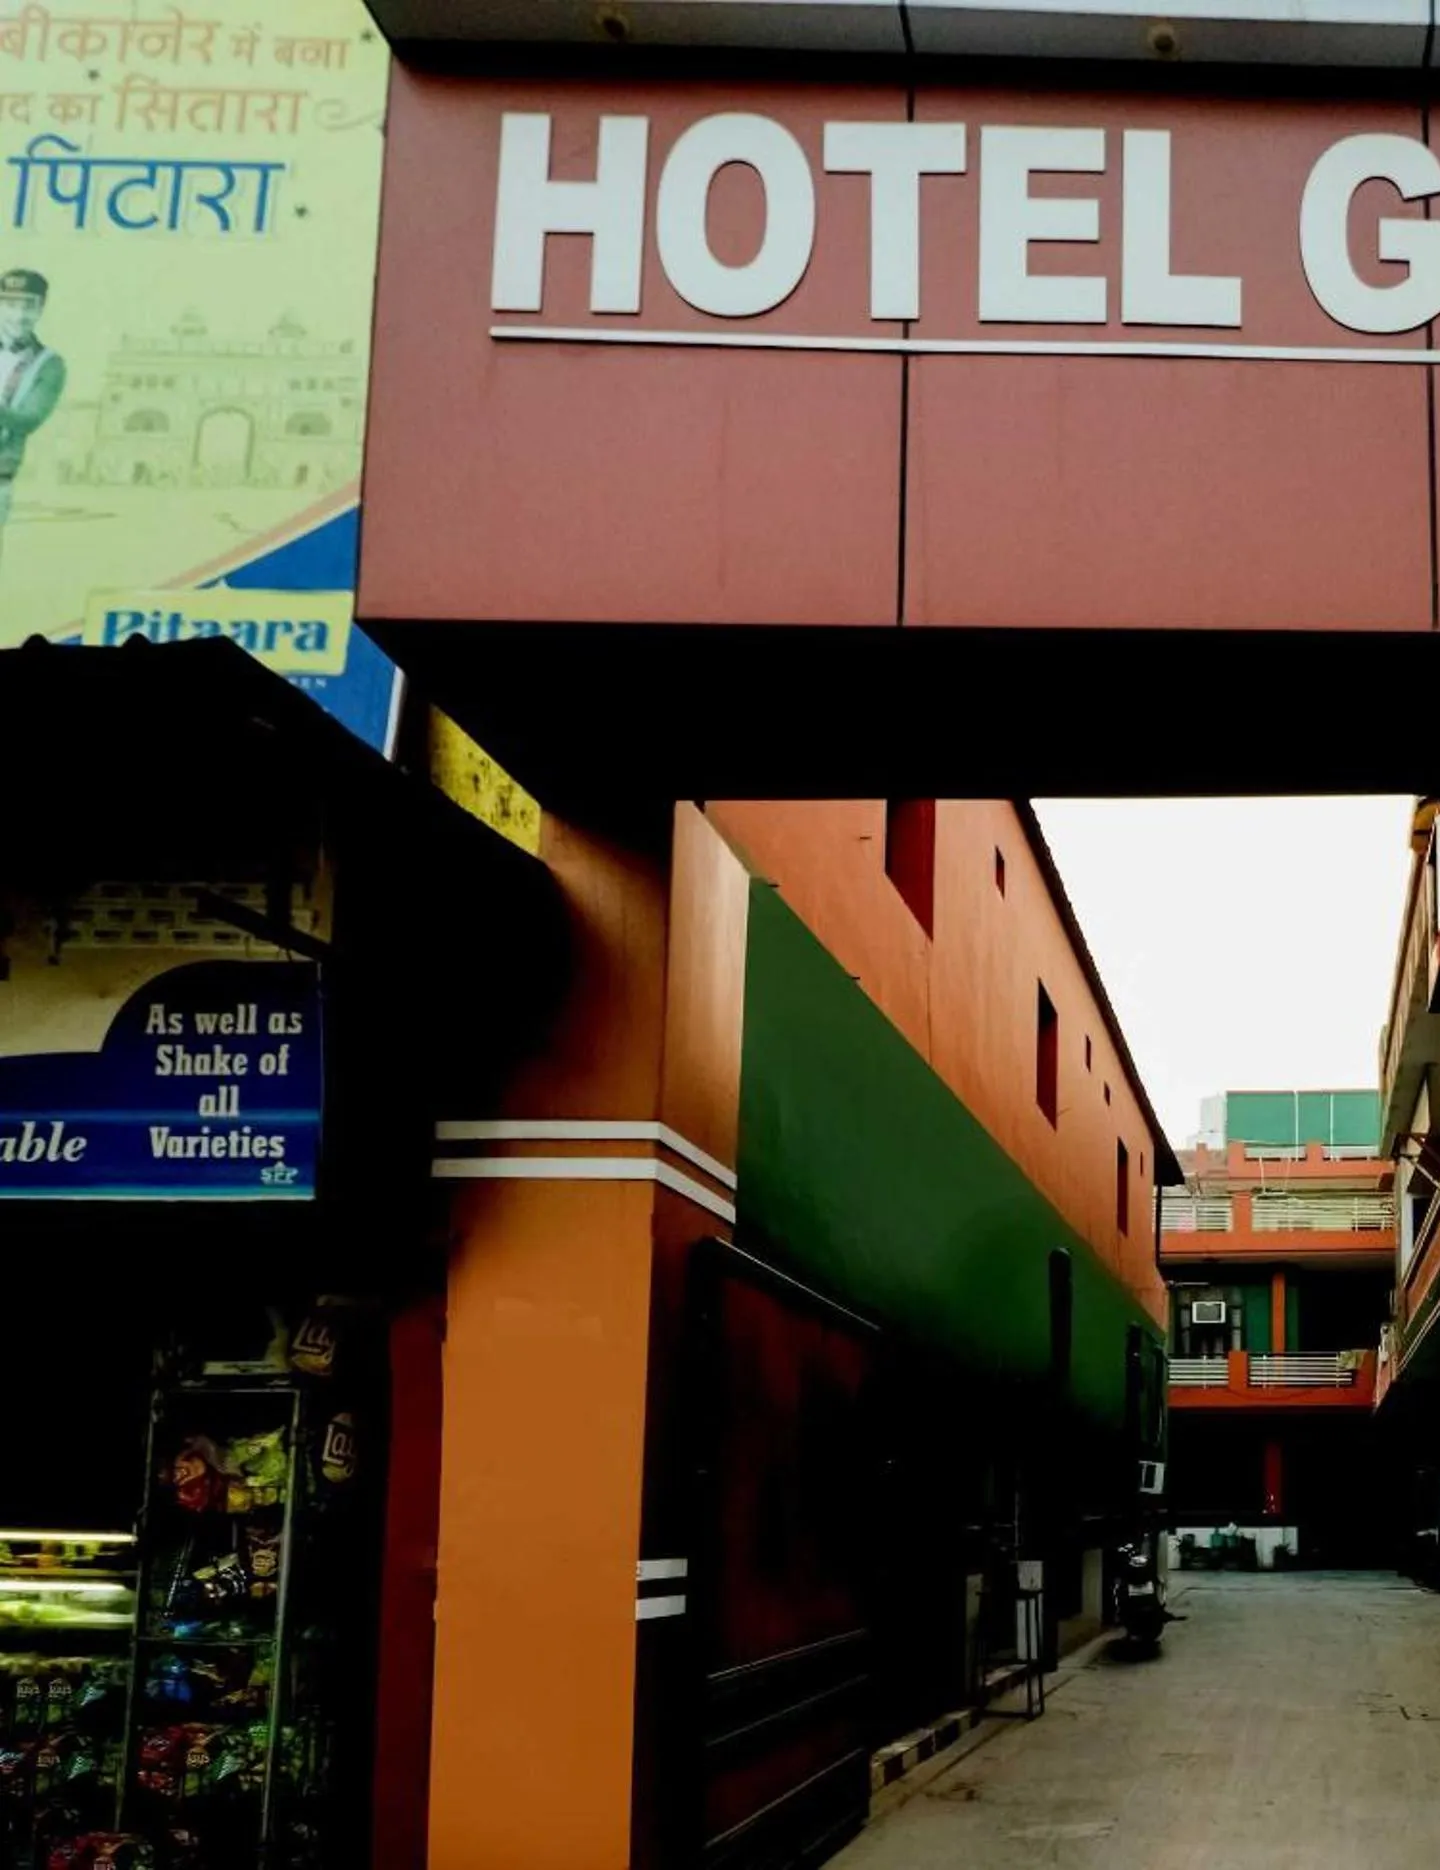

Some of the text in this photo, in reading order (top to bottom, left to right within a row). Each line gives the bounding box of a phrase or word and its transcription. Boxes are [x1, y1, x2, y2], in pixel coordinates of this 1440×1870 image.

[47, 92, 104, 125] का
[112, 72, 309, 134] सितारा
[7, 133, 286, 232] पिटारा
[491, 112, 1241, 327] HOTEL
[146, 1003, 303, 1034] As well as
[155, 1043, 290, 1076] Shake of
[198, 1085, 240, 1118] all
[149, 1126, 286, 1159] Varieties
